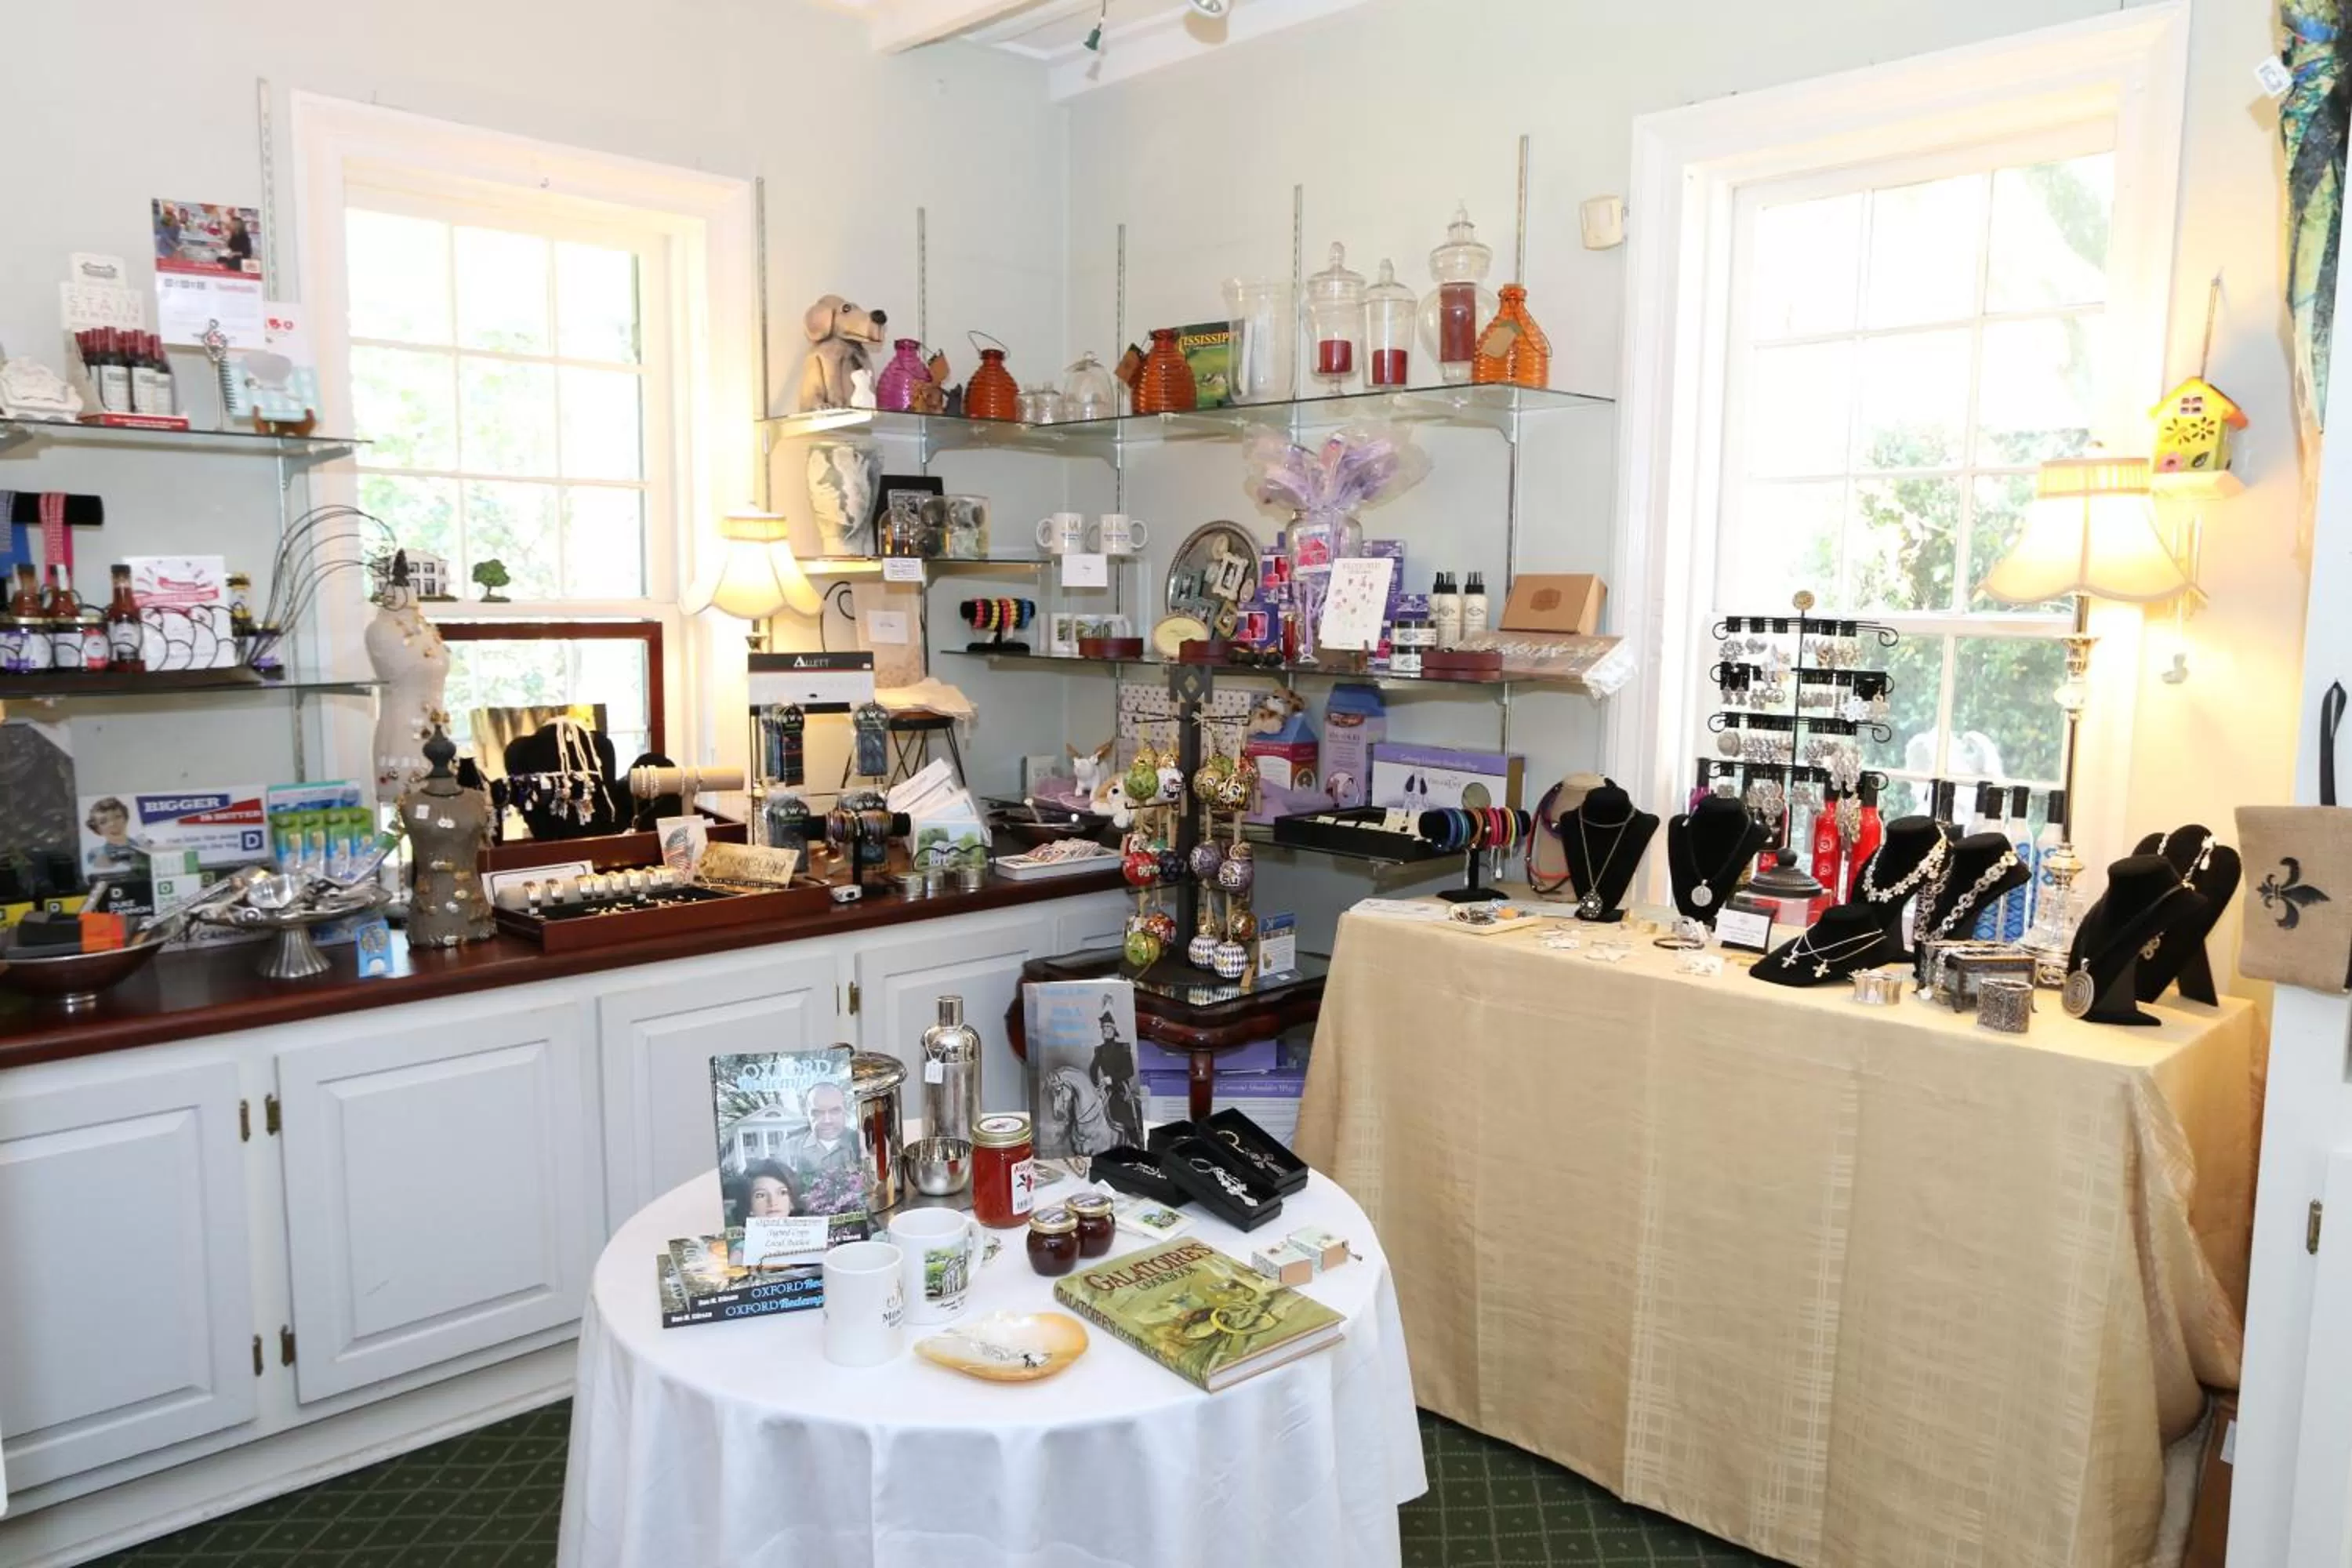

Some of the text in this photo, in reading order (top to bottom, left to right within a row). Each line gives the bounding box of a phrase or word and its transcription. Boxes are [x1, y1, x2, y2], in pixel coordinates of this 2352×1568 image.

[144, 797, 220, 813] BIGGER
[245, 833, 260, 848] D
[111, 887, 123, 898] D
[742, 1058, 832, 1080] OXFORD
[751, 1280, 804, 1299] OXFORD
[725, 1299, 779, 1316] OXFORD
